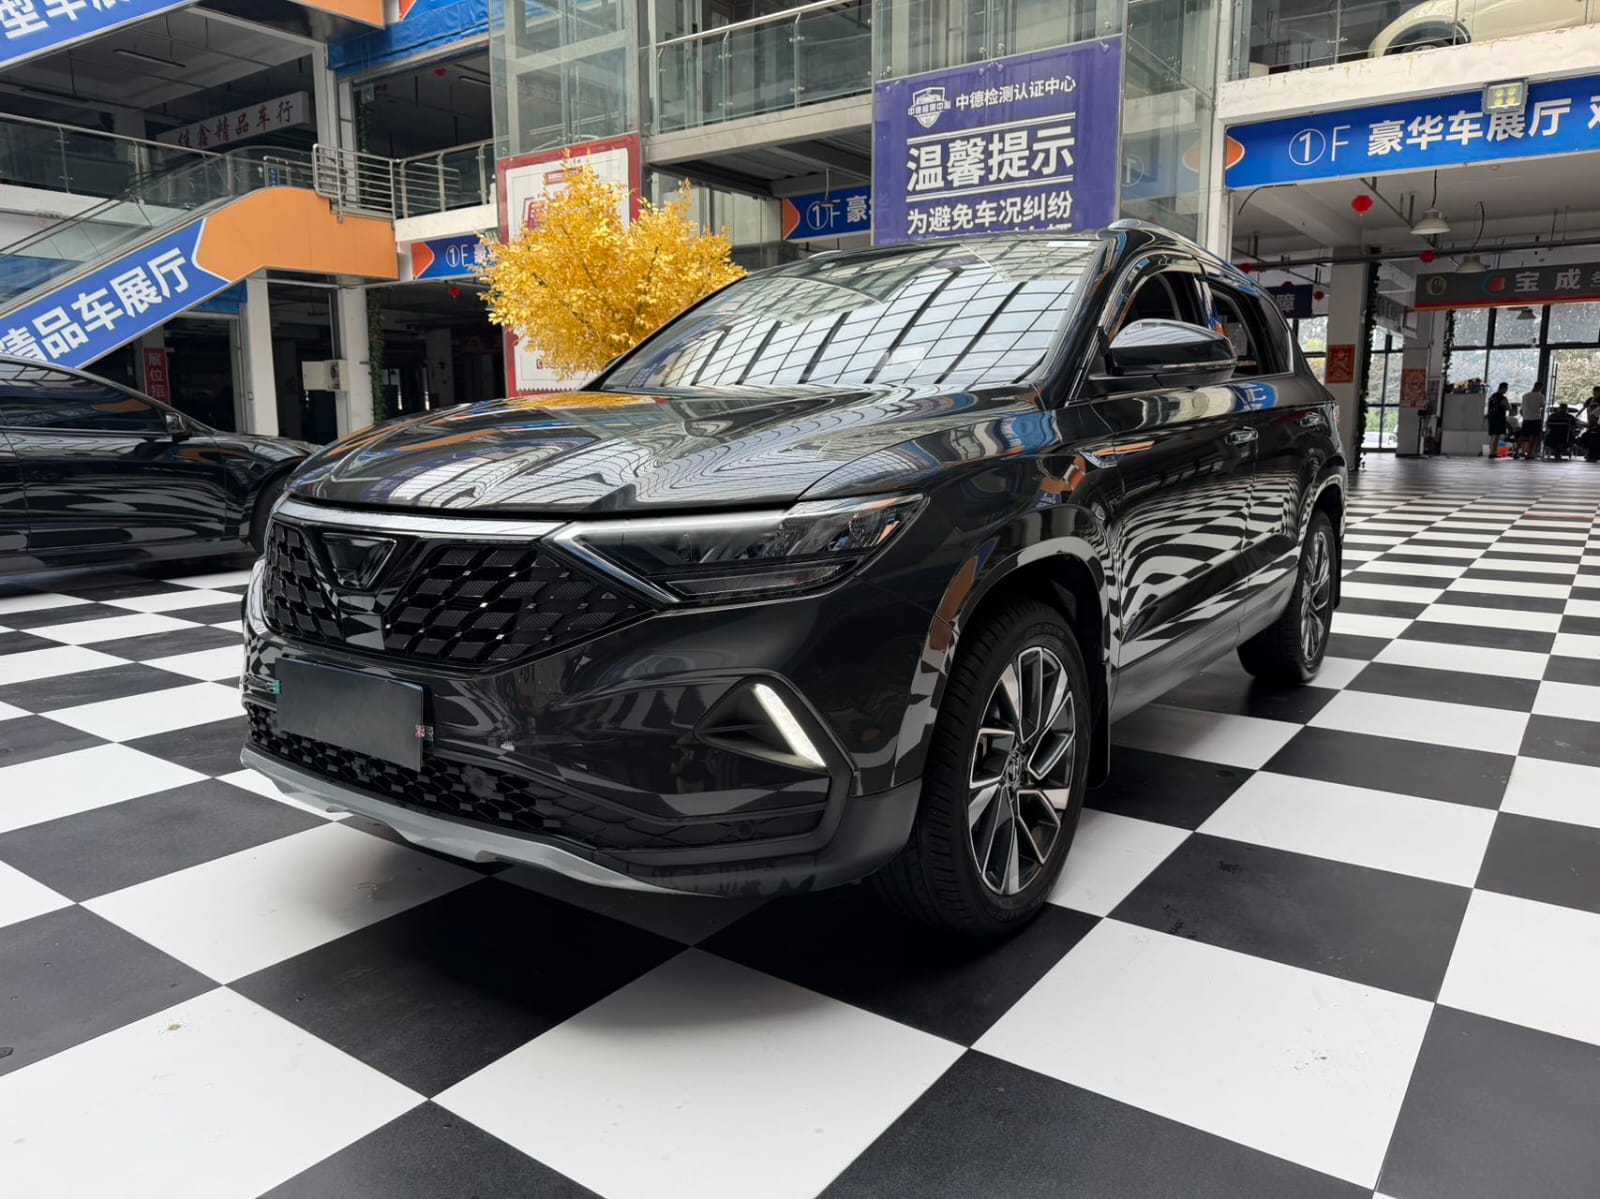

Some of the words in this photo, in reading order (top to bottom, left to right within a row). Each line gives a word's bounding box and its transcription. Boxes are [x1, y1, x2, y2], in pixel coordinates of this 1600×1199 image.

[955, 75, 1077, 111] 中德检测认证中心
[1367, 97, 1572, 157] 豪华车展厅
[906, 125, 1076, 193] 温馨提示
[906, 190, 1074, 235] 为避免车况纠纷
